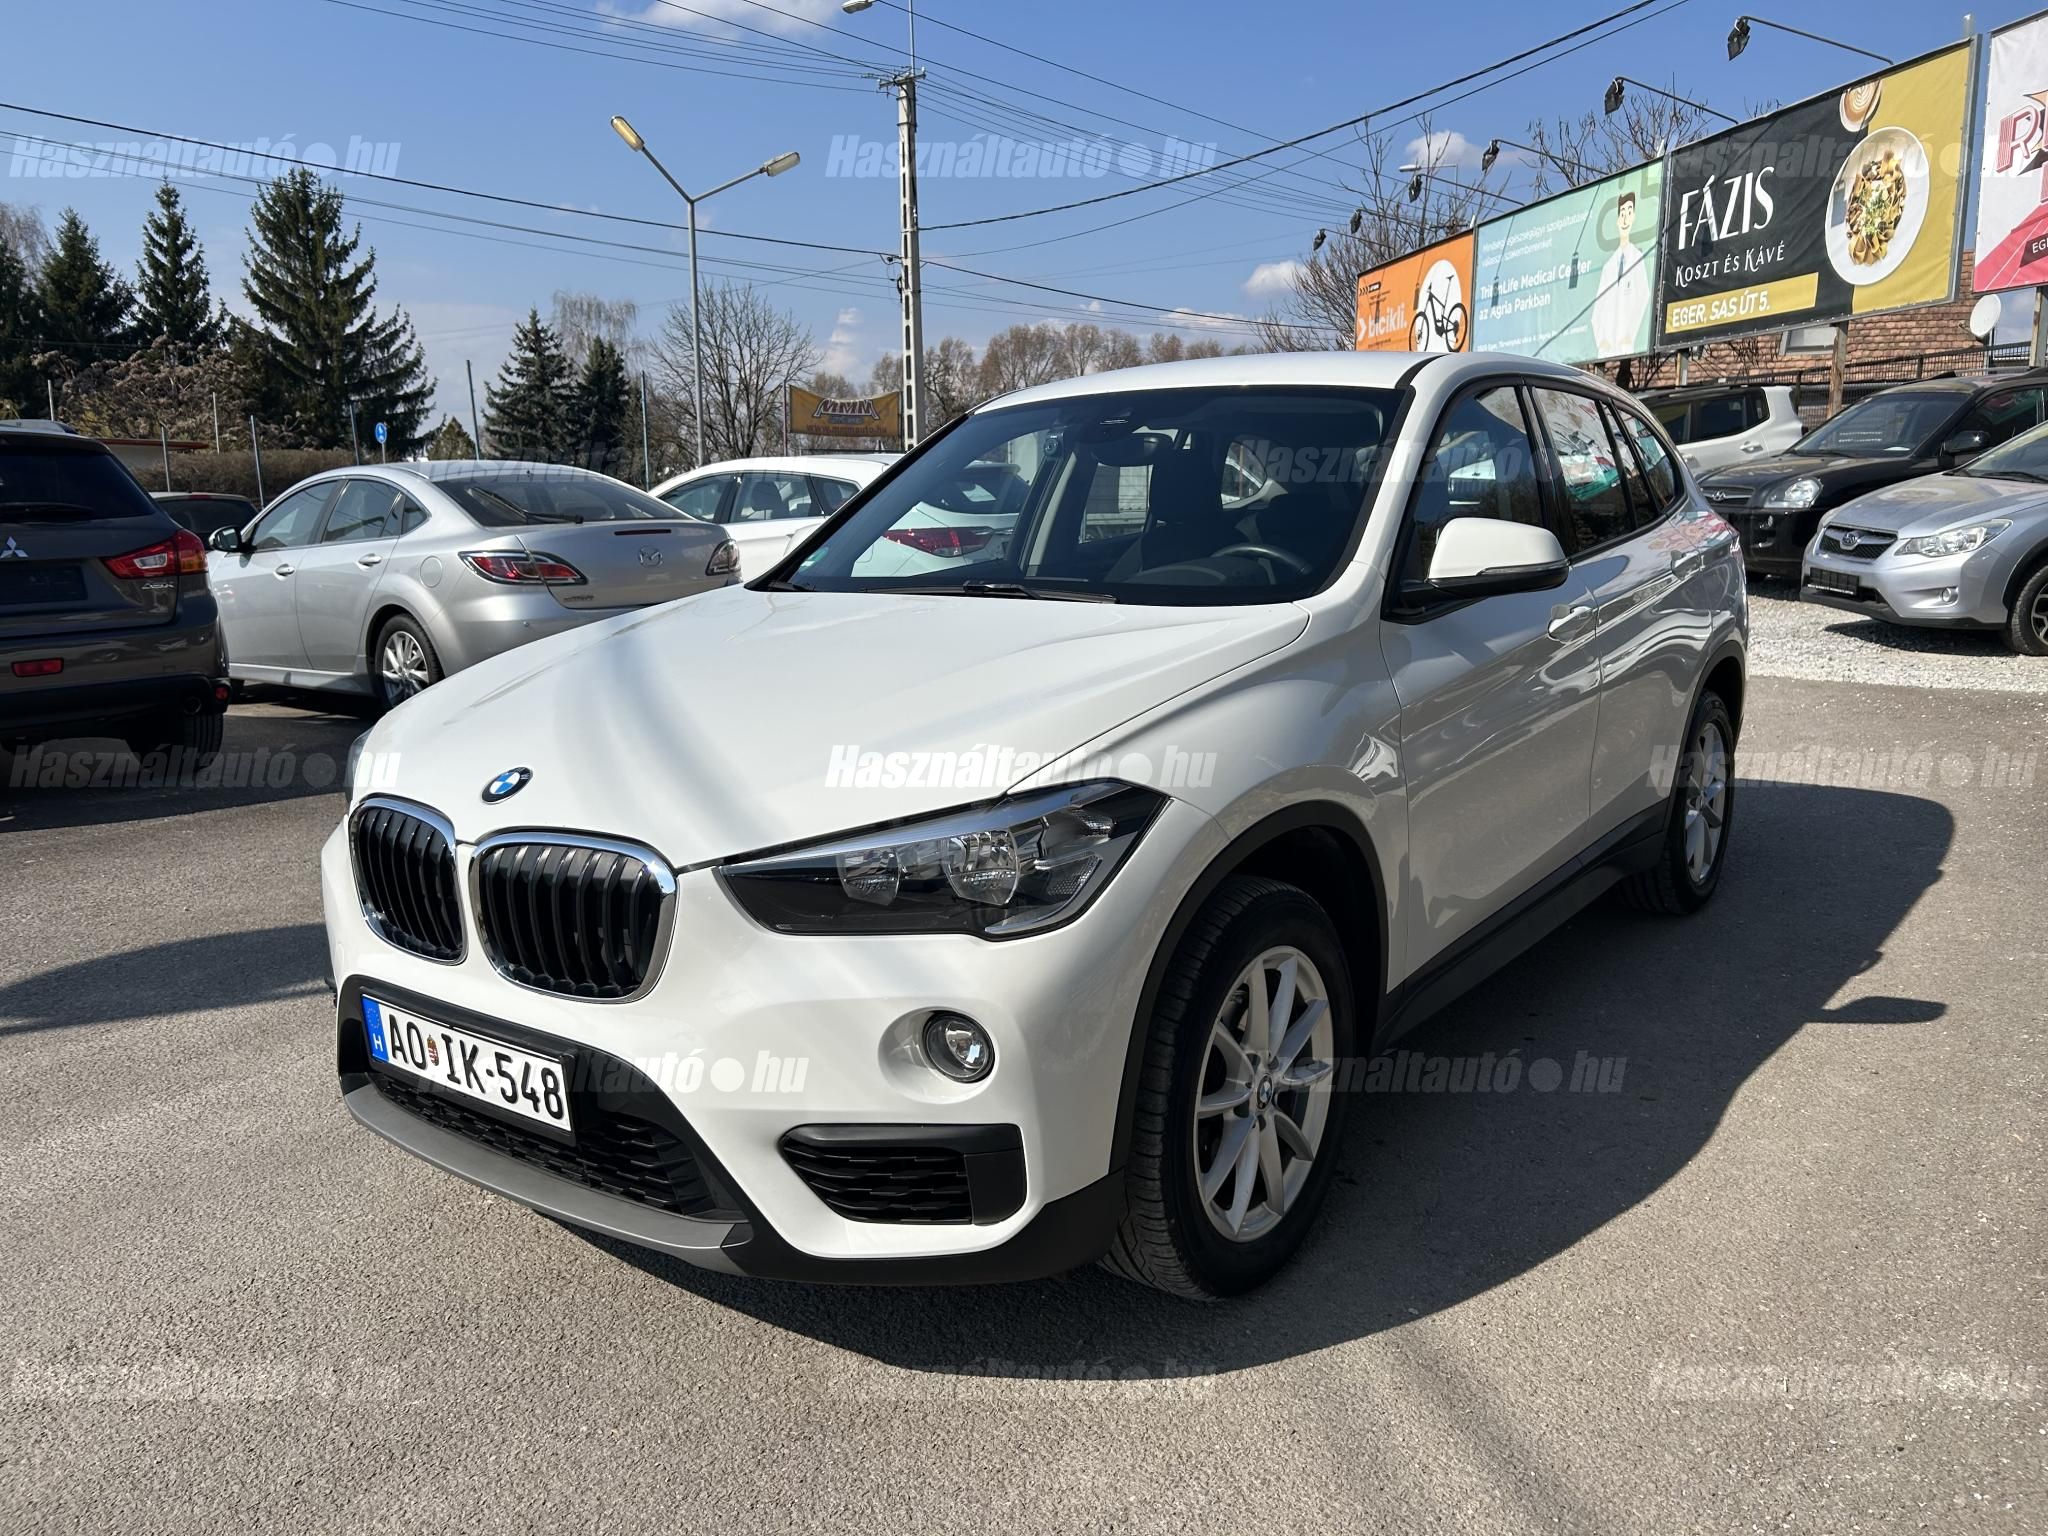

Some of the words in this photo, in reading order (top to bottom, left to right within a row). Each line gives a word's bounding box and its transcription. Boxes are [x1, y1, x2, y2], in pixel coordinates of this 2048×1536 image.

[1678, 166, 1775, 250] FÁZIS
[2032, 237, 2048, 254] EG
[1520, 266, 1556, 289] Medical
[1558, 260, 1592, 280] Center
[1675, 260, 1719, 288] KOSZT
[1723, 254, 1740, 273] ÉS
[1744, 240, 1785, 272] KÁVÉ
[1479, 308, 1488, 320] az
[1490, 302, 1512, 320] Agria
[1514, 293, 1551, 313] Parkban
[1709, 297, 1737, 321] SAS
[1739, 291, 1758, 313] ÚT
[1759, 291, 1771, 312] 5.
[373, 1033, 383, 1052] H
